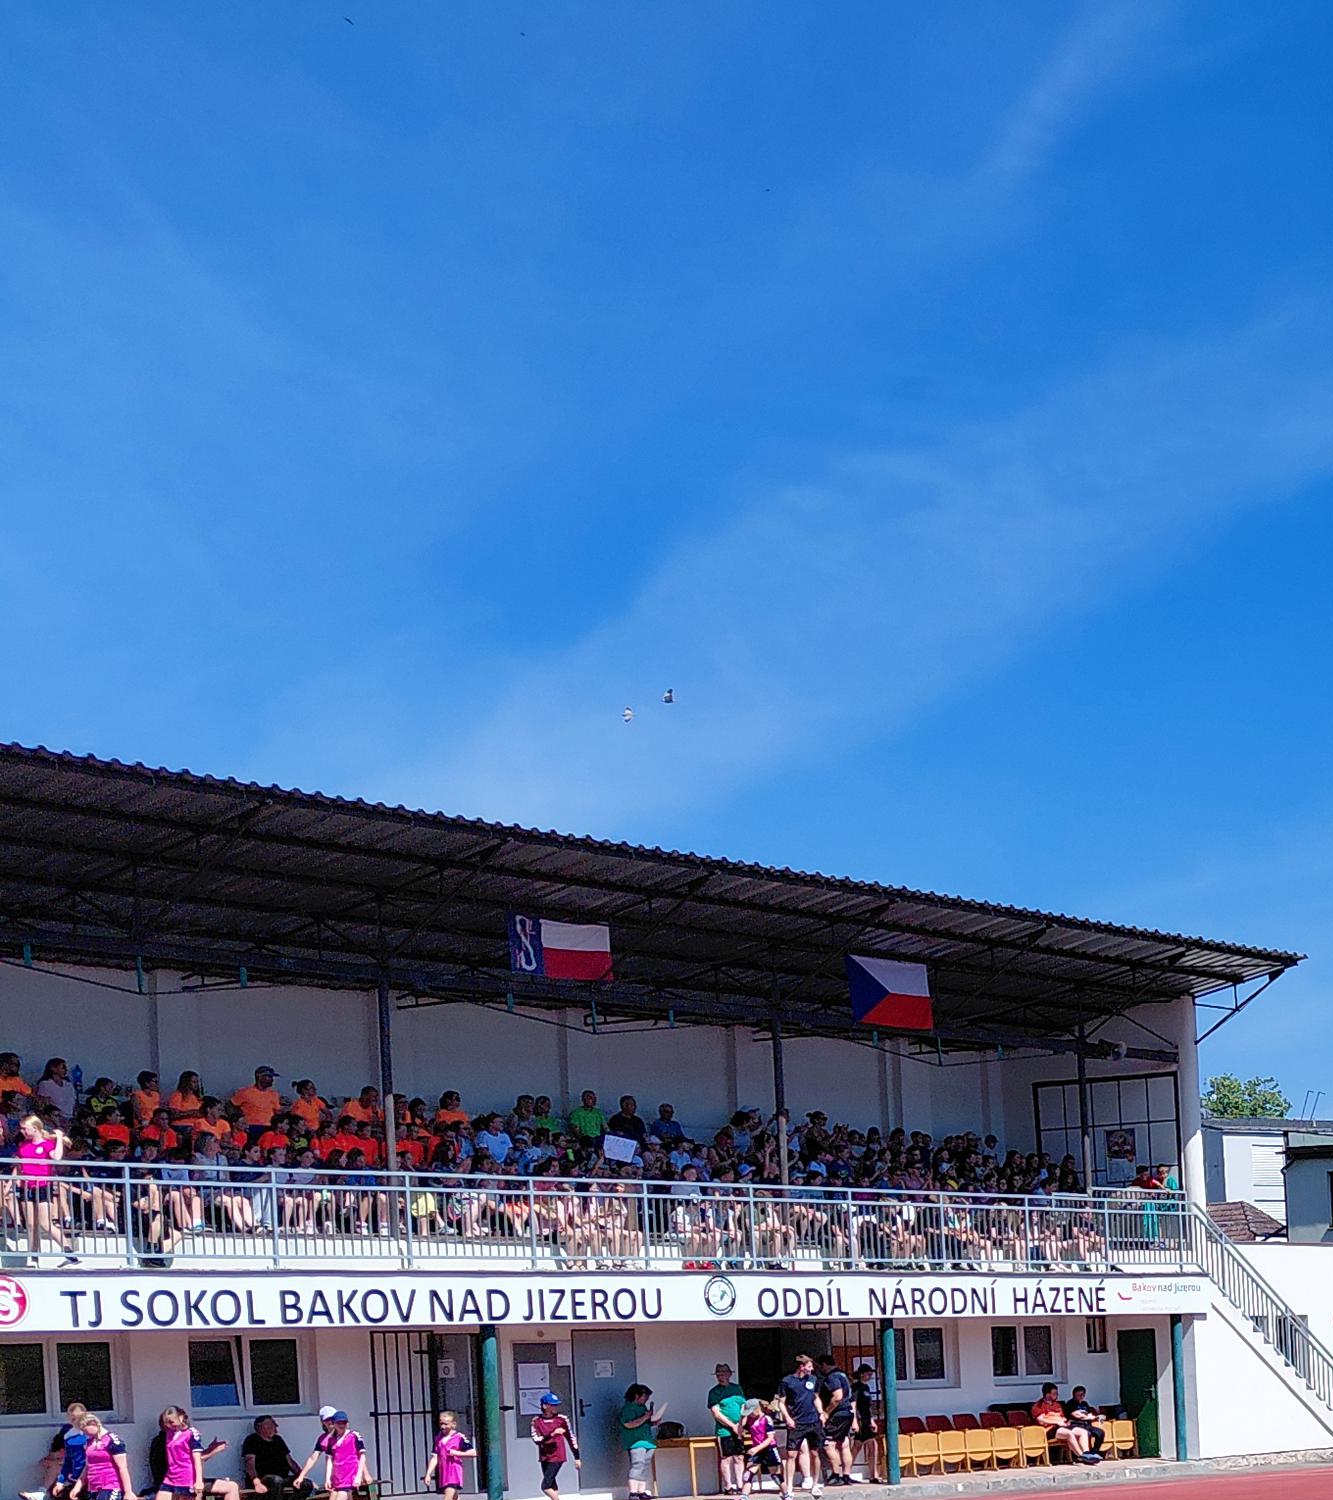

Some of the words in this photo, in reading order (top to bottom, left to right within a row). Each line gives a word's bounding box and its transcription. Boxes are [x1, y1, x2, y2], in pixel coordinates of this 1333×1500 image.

[60, 1290, 103, 1327] TJ
[121, 1289, 266, 1326] SOKOL
[280, 1289, 416, 1324] BAKOV
[430, 1289, 511, 1323] NAD
[522, 1287, 663, 1322] JIZEROU
[757, 1279, 850, 1318] ODDÍL
[868, 1279, 996, 1316] NÁRODNÍ
[1013, 1278, 1107, 1315] HÁZENÉ
[1132, 1282, 1157, 1292] Bakov
[1158, 1282, 1173, 1292] nad
